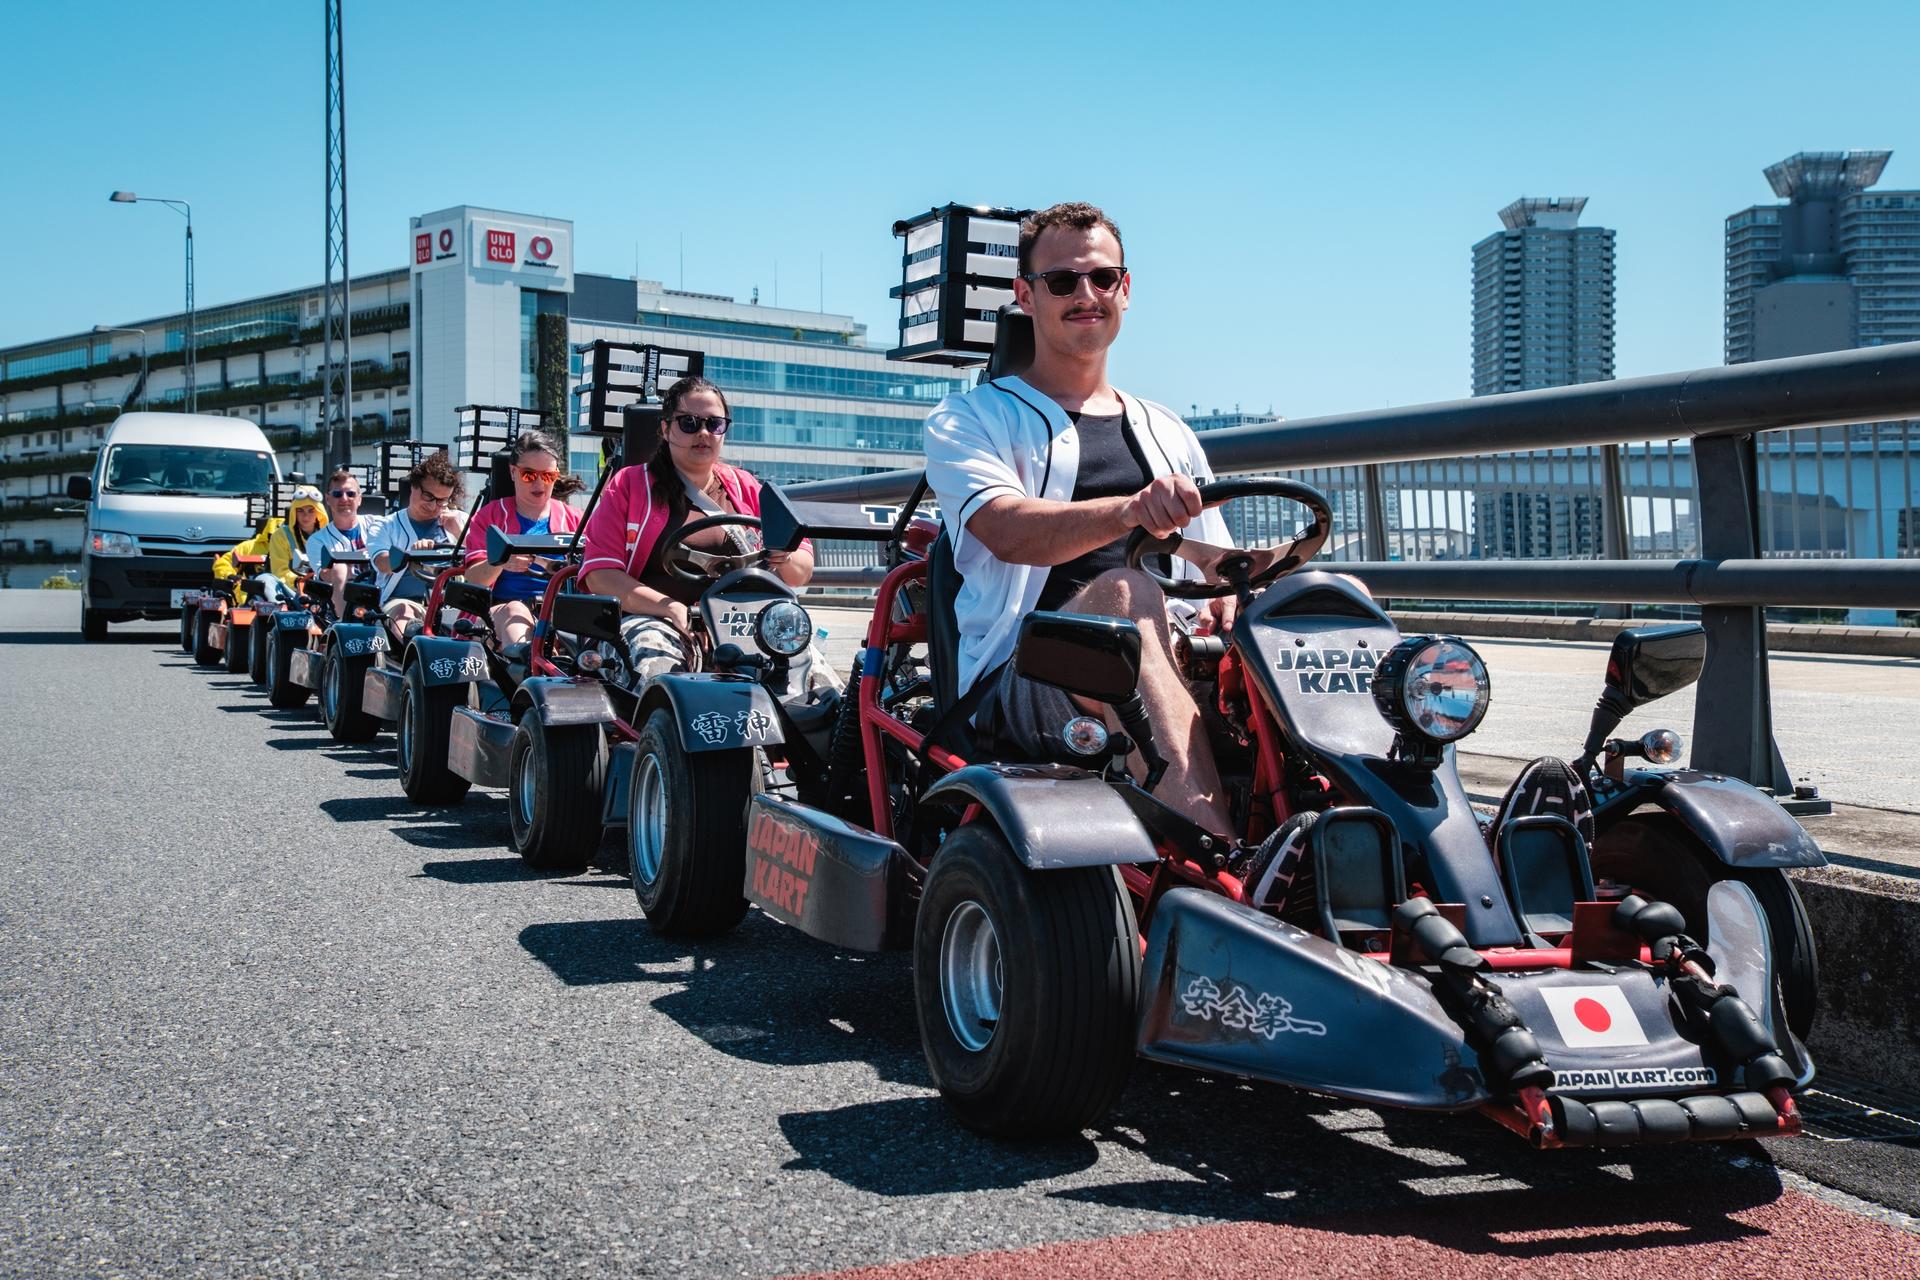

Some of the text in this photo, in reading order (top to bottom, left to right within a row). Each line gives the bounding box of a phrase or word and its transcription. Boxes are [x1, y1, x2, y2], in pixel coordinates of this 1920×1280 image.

[490, 233, 511, 247] UNI
[984, 243, 1019, 257] JAPAN
[490, 247, 513, 260] QLO
[980, 309, 997, 322] Fin
[648, 348, 659, 382] PANKART
[719, 611, 758, 625] JAP
[1296, 670, 1373, 694] KAR
[690, 709, 771, 744] 雷神
[750, 813, 819, 876] JAPAN
[753, 857, 809, 917] KART
[1181, 976, 1327, 1040] 安全第一
[1550, 1068, 1717, 1090] APAN KART.com
